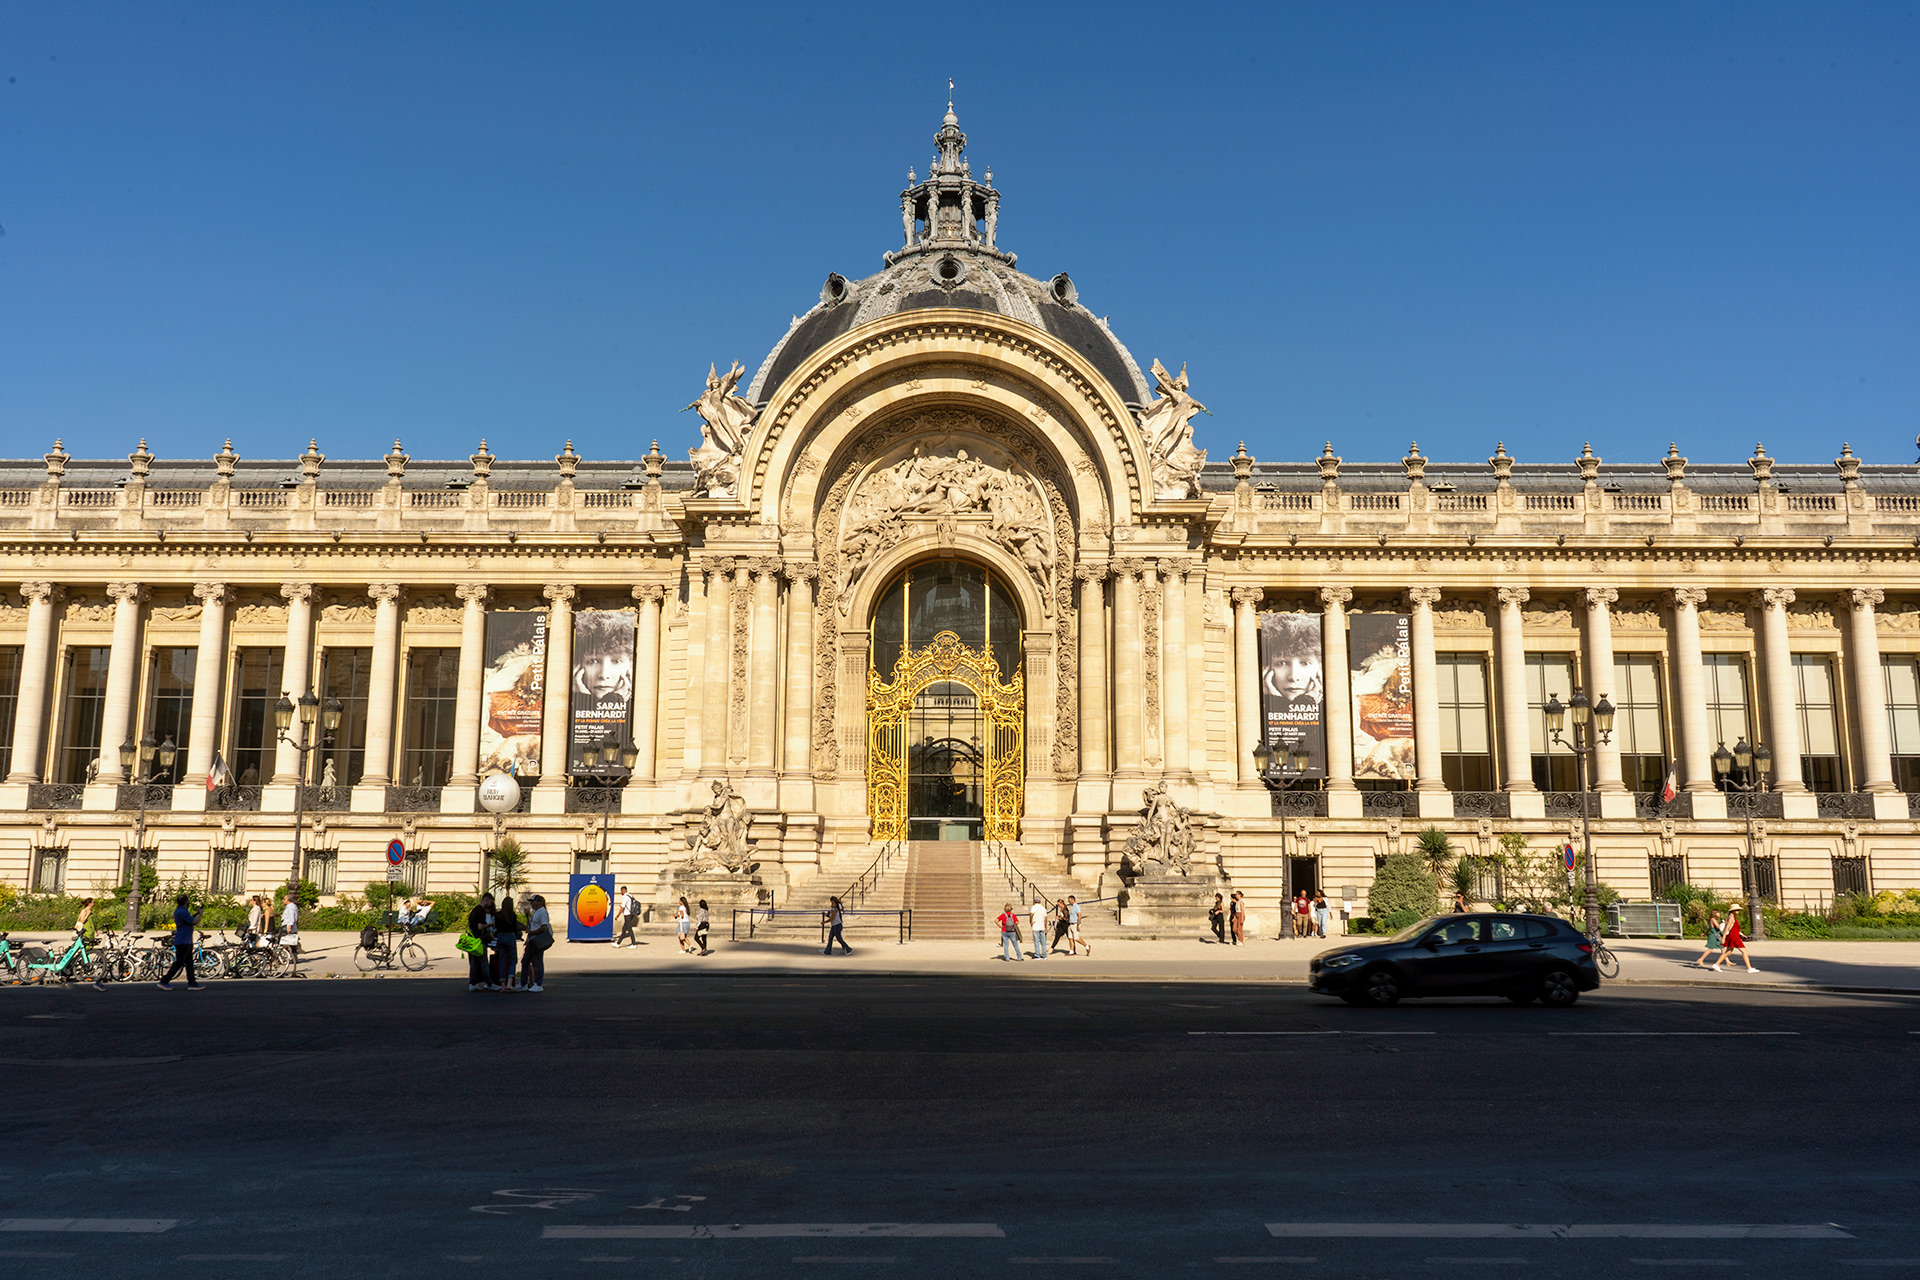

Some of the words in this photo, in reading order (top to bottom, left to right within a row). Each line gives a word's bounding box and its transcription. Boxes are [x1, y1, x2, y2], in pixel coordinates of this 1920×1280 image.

[533, 615, 546, 655] Palais
[1397, 618, 1409, 657] Palais
[531, 657, 544, 690] Petit
[1398, 660, 1410, 693] Petit
[576, 710, 627, 718] BERNHARDT
[596, 702, 626, 710] SARAH
[1268, 712, 1320, 720] BERNHARDT
[1289, 704, 1320, 712] SARAH
